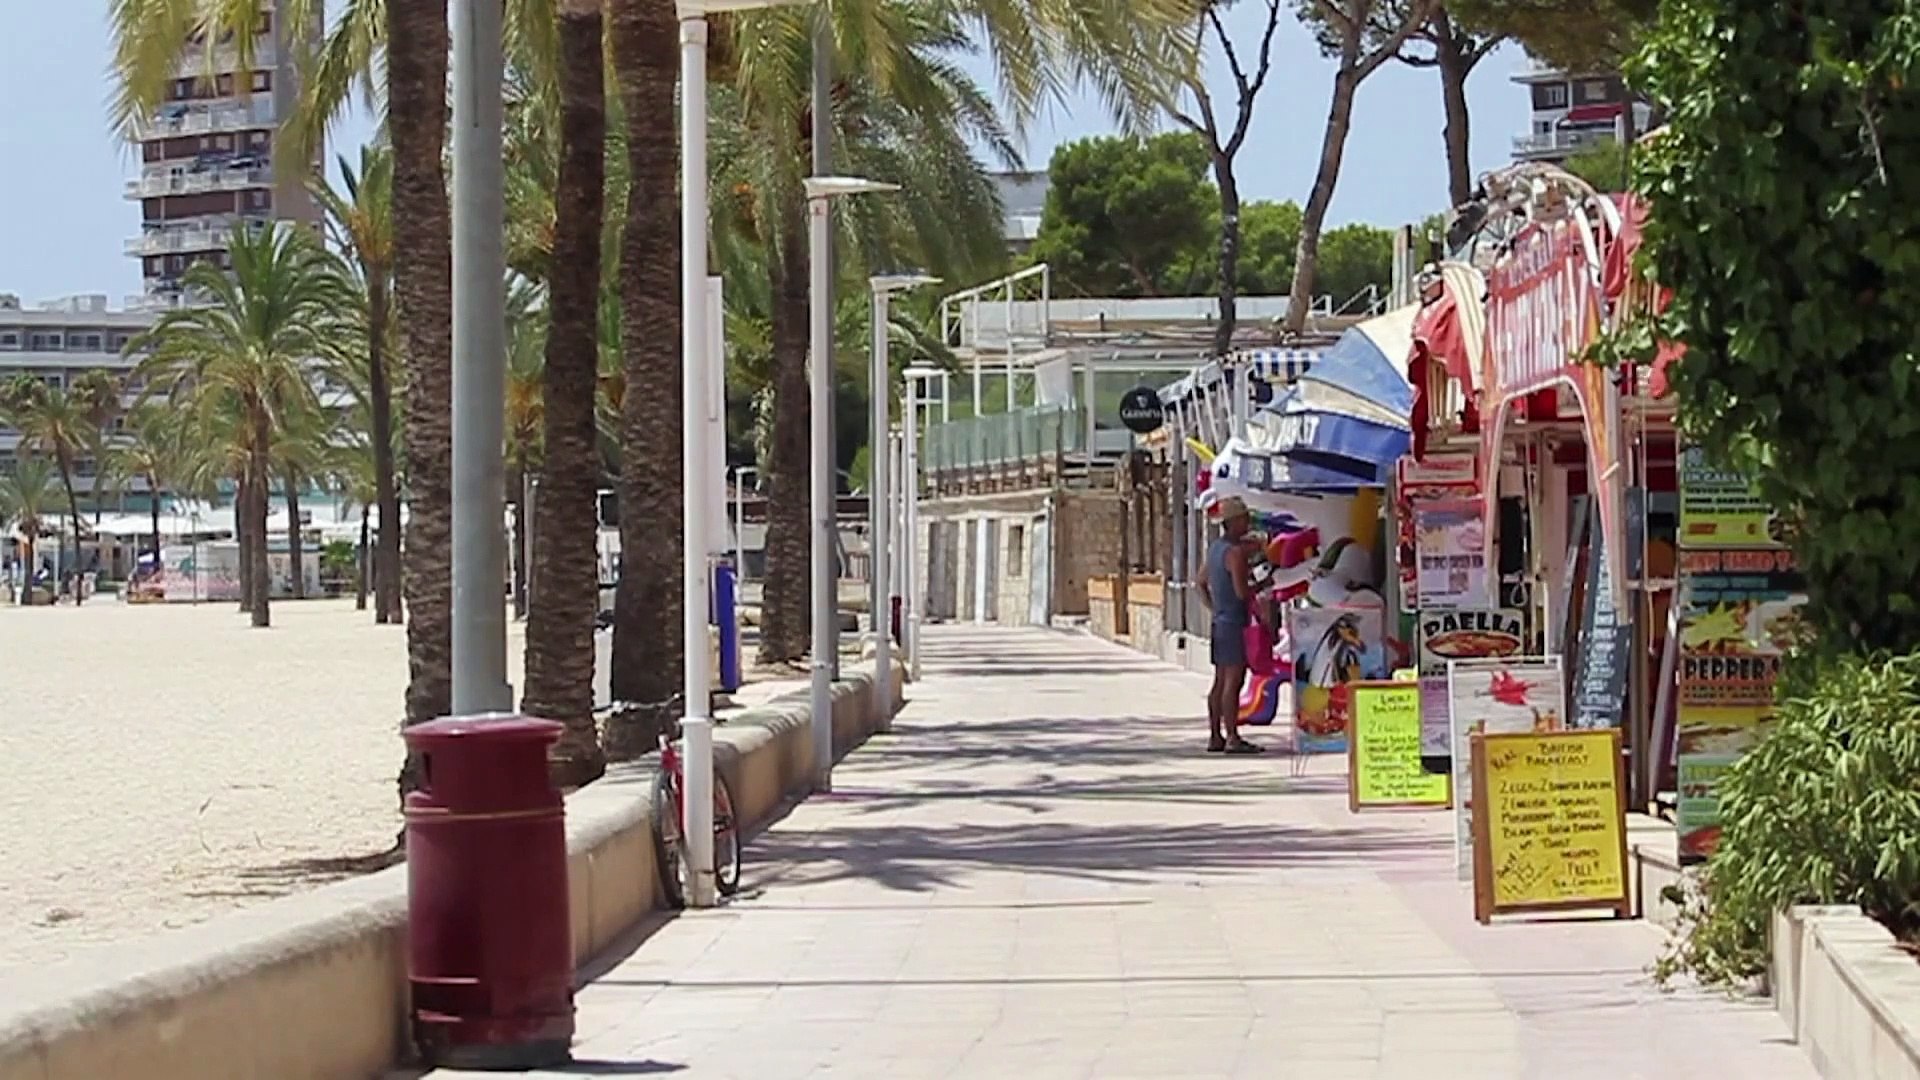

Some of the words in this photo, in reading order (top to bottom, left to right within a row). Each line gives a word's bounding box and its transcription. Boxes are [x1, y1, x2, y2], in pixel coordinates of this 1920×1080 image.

[1423, 612, 1521, 637] PAELLA
[1684, 658, 1766, 680] PEPPER
[1500, 780, 1509, 794] 2
